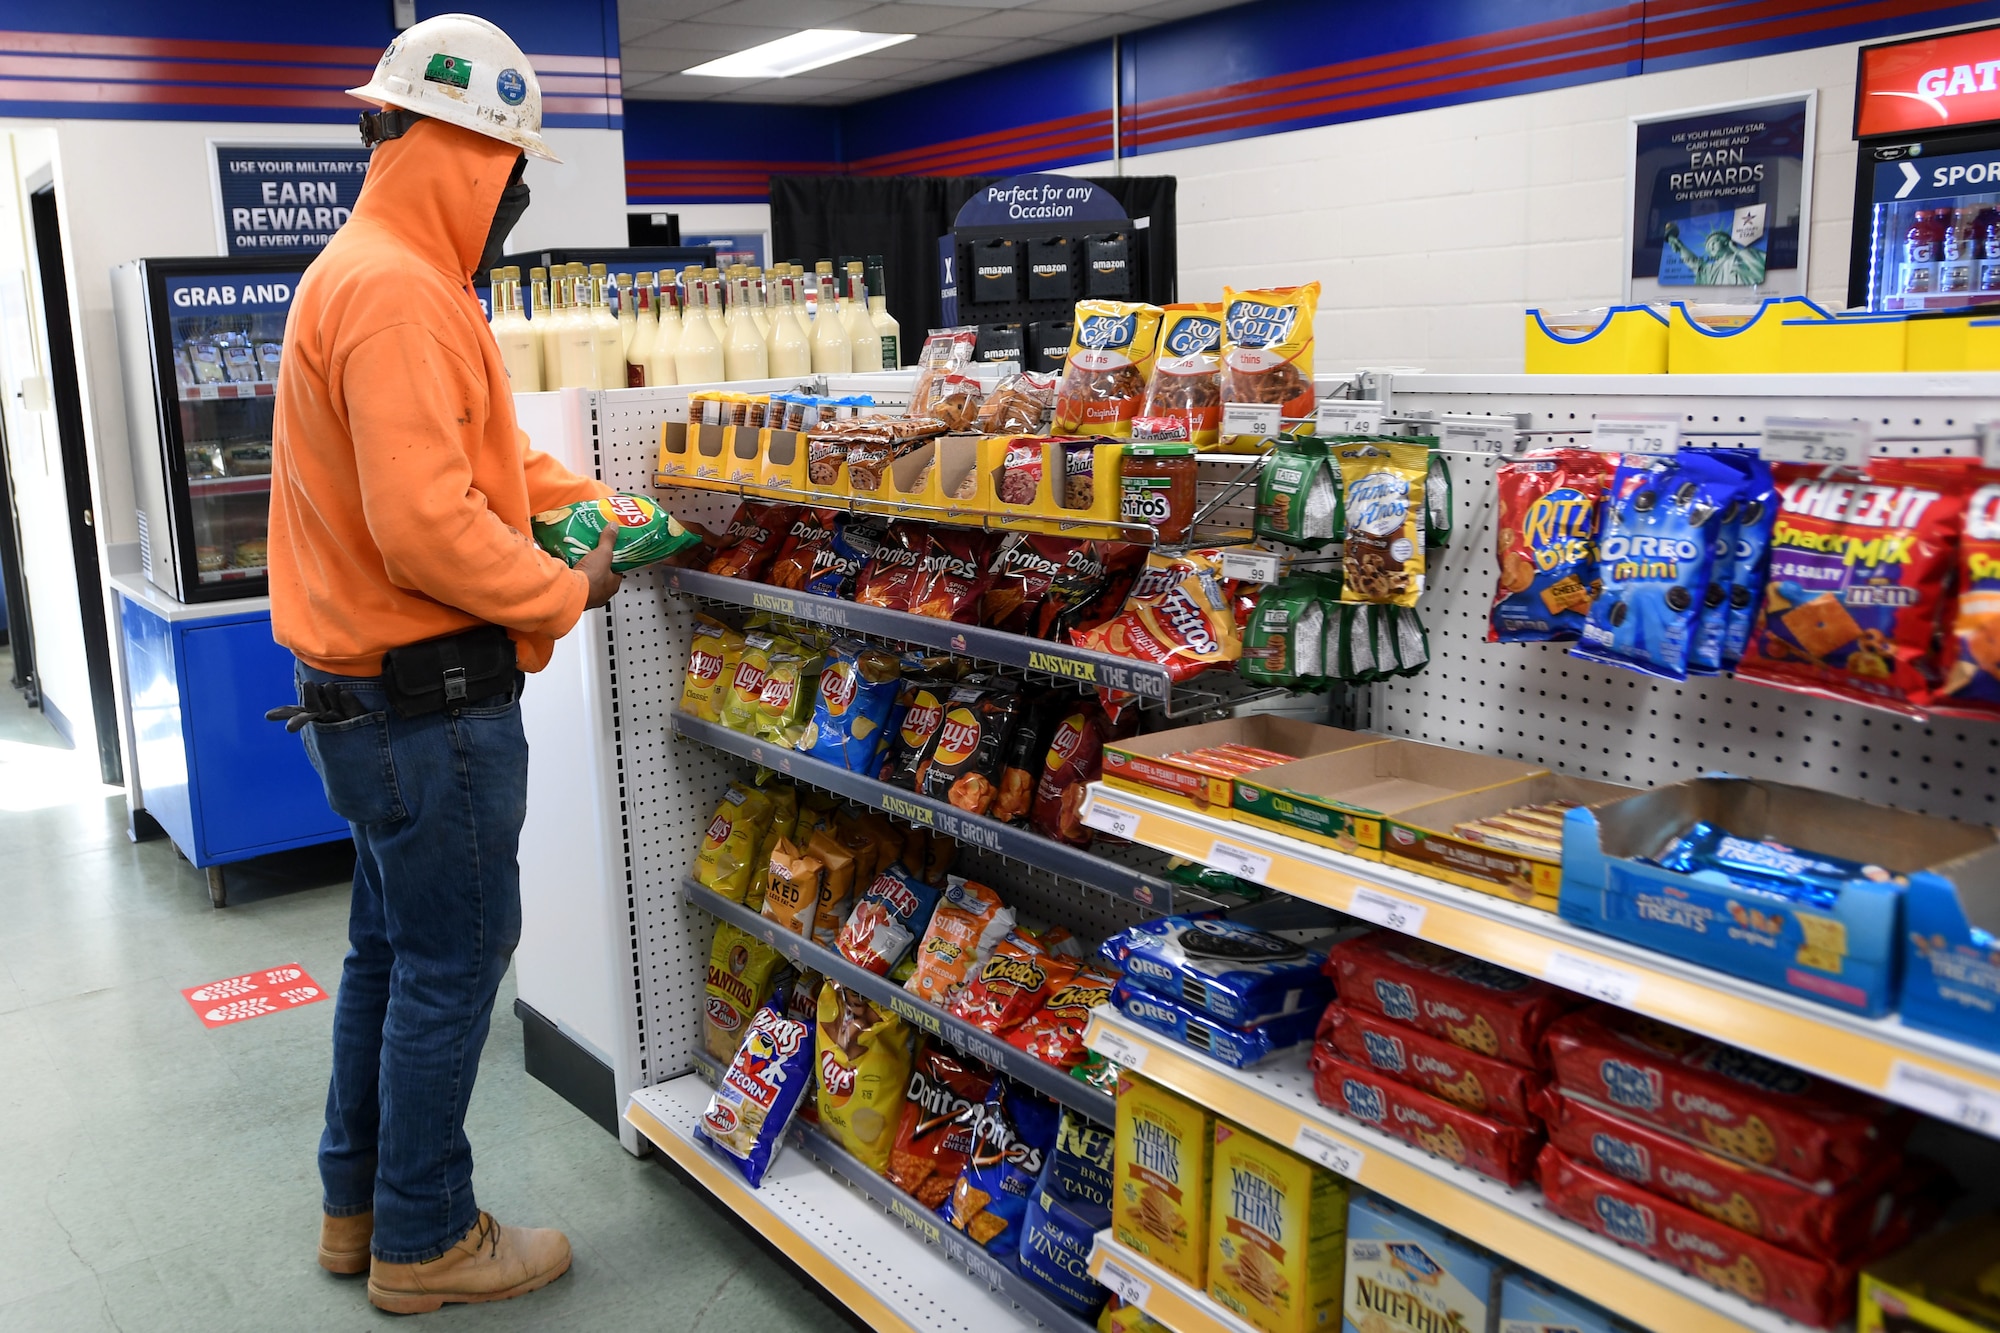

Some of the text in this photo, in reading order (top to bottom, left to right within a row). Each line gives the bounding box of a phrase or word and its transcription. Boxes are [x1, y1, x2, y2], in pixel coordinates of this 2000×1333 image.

[1917, 61, 2000, 99] GAT
[1672, 134, 1685, 143] USE
[1686, 131, 1708, 141] YOUR
[1710, 126, 1744, 137] MILITARY
[1686, 136, 1750, 151] CARD HERE AND
[230, 161, 353, 174] USE YOUR MILITARY
[1691, 147, 1744, 169] EARN
[1670, 164, 1764, 191] REWARDS
[1933, 162, 2000, 187] SPOR
[262, 181, 338, 204] EARN
[988, 184, 1093, 205] Perfect for any
[1675, 184, 1756, 201] ON EVERY PURCHASE
[1009, 203, 1073, 219] Occasion
[236, 235, 256, 247] ON
[259, 234, 300, 247] EVERY
[978, 265, 1013, 275] amazon
[1032, 263, 1067, 274] amazon
[1092, 259, 1125, 269] amazon
[173, 284, 290, 307] GRAB AND
[1238, 301, 1291, 324] ROLD
[1229, 318, 1286, 343] GOLD
[983, 347, 1020, 359] amazon
[1085, 354, 1109, 365] thns
[1240, 354, 1261, 365] thins
[1250, 423, 1266, 434] .99
[1344, 421, 1370, 433] 1.49
[1473, 440, 1503, 453] 1.79
[1627, 438, 1662, 451] 1.79
[1803, 445, 1847, 461] 2.29
[1346, 479, 1410, 504] Famous
[607, 495, 647, 525] Lay's
[1352, 501, 1406, 529] Amos
[727, 521, 770, 544] Doritos
[1523, 499, 1593, 547] RITZ
[1602, 536, 1697, 561] OREO
[1771, 520, 1845, 555] Snack
[815, 549, 859, 577] ritos
[1248, 568, 1265, 580] .99
[1615, 558, 1678, 580] mini
[1796, 564, 1843, 581] SALTY
[753, 592, 850, 626] ANSWER THE GROWL
[1160, 585, 1219, 655] Fritos
[1131, 626, 1167, 663] ORIGINA
[688, 652, 722, 679] Lay's
[1028, 651, 1097, 682] ANSWER
[1101, 665, 1130, 689] THE
[686, 689, 709, 702] Classic
[761, 680, 794, 707] Lay's
[902, 706, 940, 736] Lay's
[1130, 761, 1150, 774] CHEESE
[1156, 767, 1176, 781] PEANUT
[1176, 773, 1197, 787] BUTTER
[882, 794, 1003, 850] ANSWER THE GROWL
[1300, 807, 1330, 824] CHEDDAR
[771, 878, 800, 903] KED
[867, 872, 919, 918] RUFFLES
[934, 915, 976, 942] SIMPLY
[1637, 901, 1707, 933] TREATS
[926, 936, 962, 959] Cheetos
[1192, 919, 1283, 951] OREO
[929, 963, 957, 981] CHEDDAR
[980, 955, 1046, 990] Cheetos
[1128, 956, 1174, 981] OREO
[707, 965, 753, 1009] SANTITAS
[718, 1012, 736, 1027] ONLY
[1128, 1000, 1177, 1025] OREO
[890, 995, 1009, 1071] ANSWER THE GROWL
[1132, 1116, 1181, 1158] WHEAT
[1133, 1136, 1180, 1185] THINS
[1080, 1166, 1113, 1189] BRAN
[1231, 1167, 1286, 1213] WHEAT
[1231, 1190, 1284, 1242] THINS
[1042, 1220, 1064, 1242] SEA
[890, 1197, 1006, 1291] ANSWER THE GROWL
